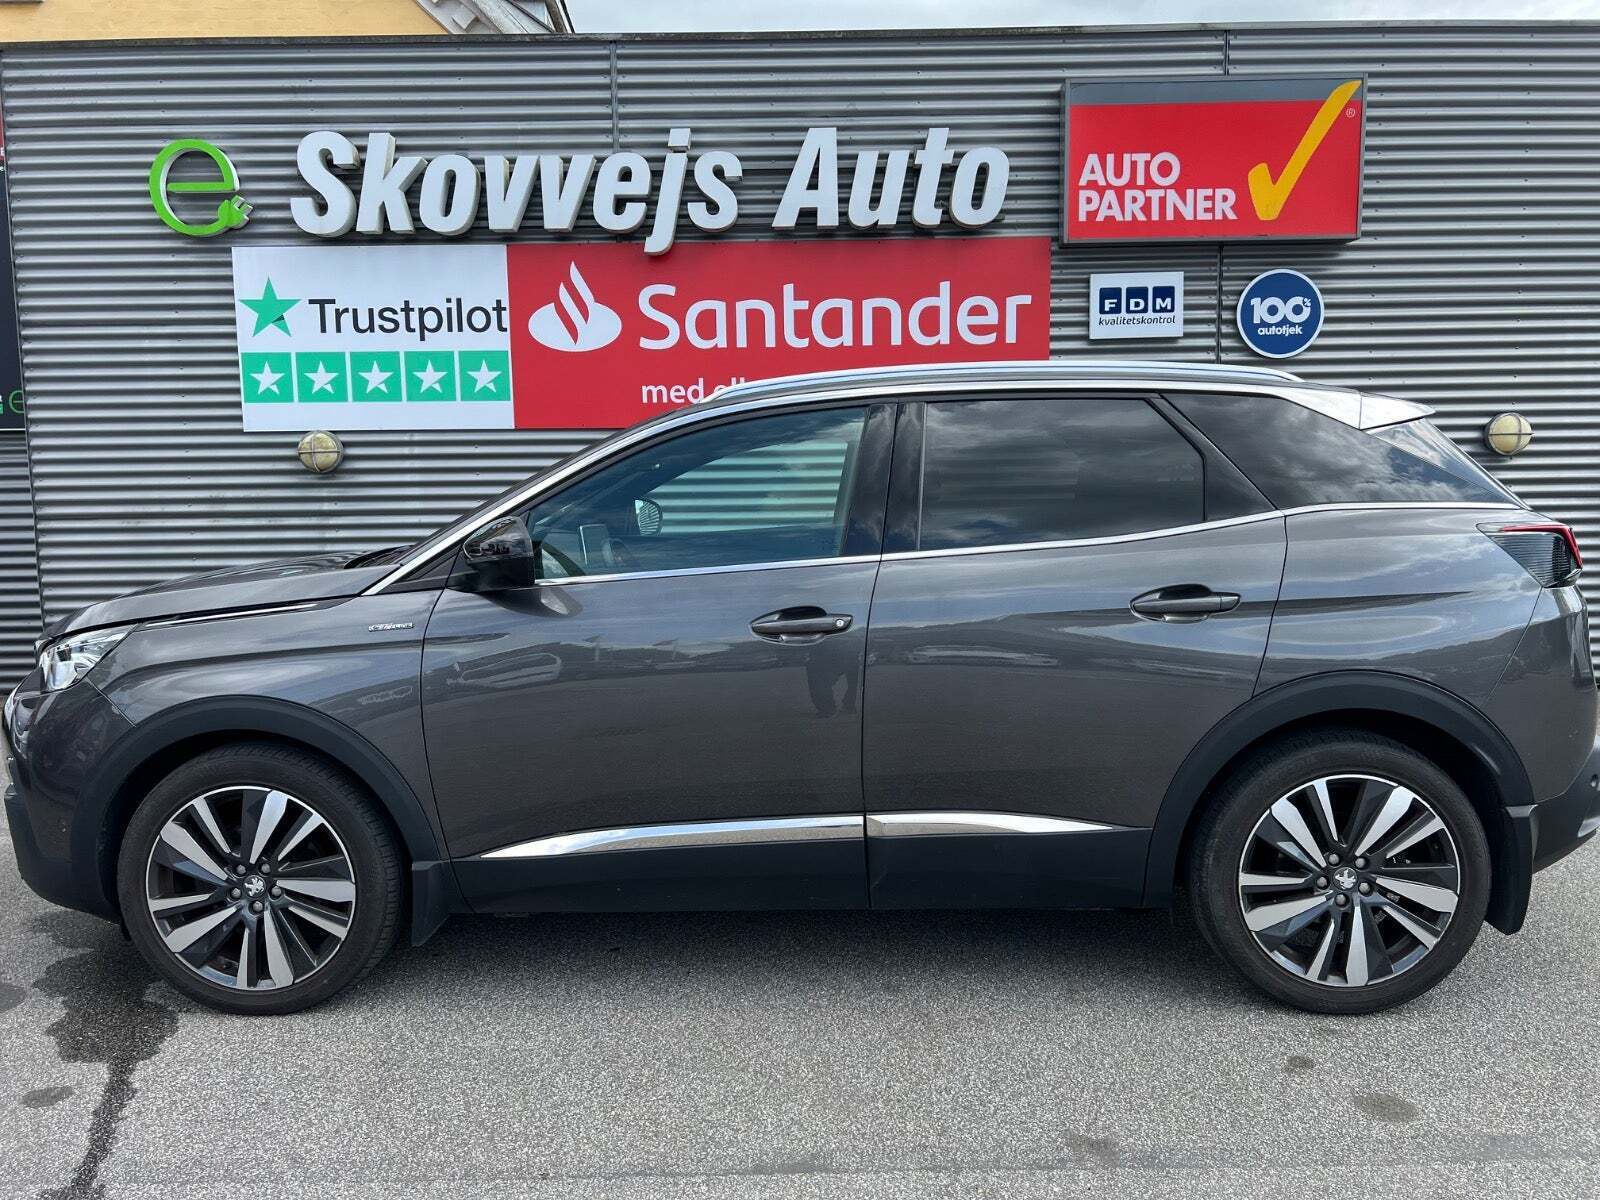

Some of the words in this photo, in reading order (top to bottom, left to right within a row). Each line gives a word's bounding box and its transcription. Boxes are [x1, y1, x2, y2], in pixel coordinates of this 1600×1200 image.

[1079, 152, 1181, 188] AUTO
[290, 128, 743, 256] Skovvejs
[772, 127, 1010, 230] Auto
[1078, 188, 1238, 222] PARTNER
[308, 298, 508, 342] Trustpilot
[638, 281, 1032, 351] Santander
[1098, 315, 1176, 326] kvalitetskontrol
[1257, 324, 1303, 336] autotjek
[641, 377, 704, 404] med
